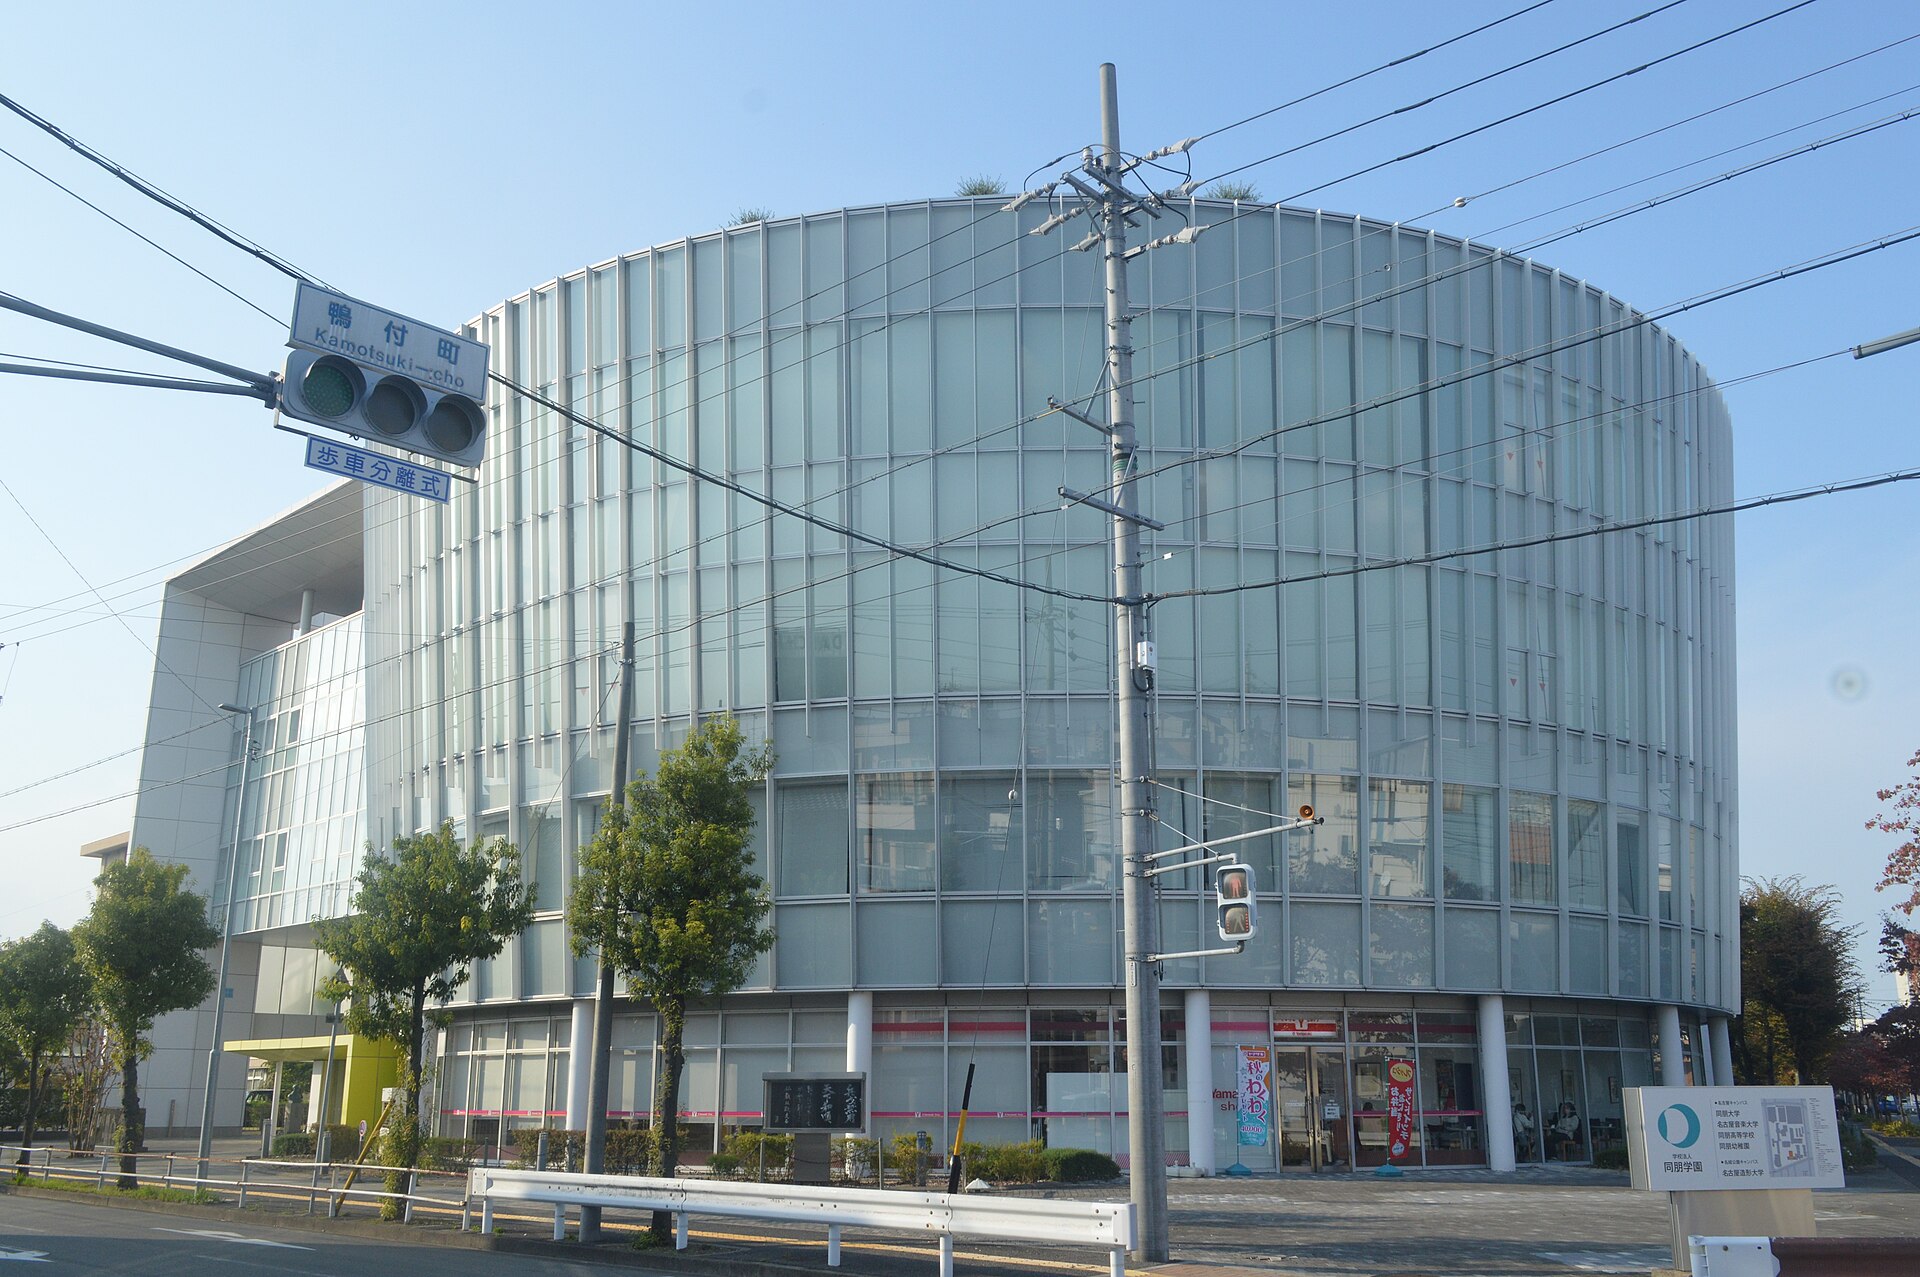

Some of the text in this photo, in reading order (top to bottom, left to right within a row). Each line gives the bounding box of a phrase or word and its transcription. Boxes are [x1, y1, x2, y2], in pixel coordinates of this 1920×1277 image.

[328, 301, 460, 366] 鴨付町
[315, 327, 464, 388] Kamotsuki-cho
[317, 446, 441, 497] 歩車分離式
[1246, 1061, 1266, 1123] 秋のわくわく
[1220, 1101, 1238, 1111] sh
[1715, 1109, 1741, 1118] 同朋大学
[1717, 1120, 1759, 1129] 名古屋音楽大学
[1718, 1131, 1755, 1140] 同朋高等学校
[1719, 1142, 1750, 1150] 同朋幼稚園
[1663, 1161, 1703, 1173] 同朋学園
[1722, 1168, 1765, 1177] 名古屋造形大学
